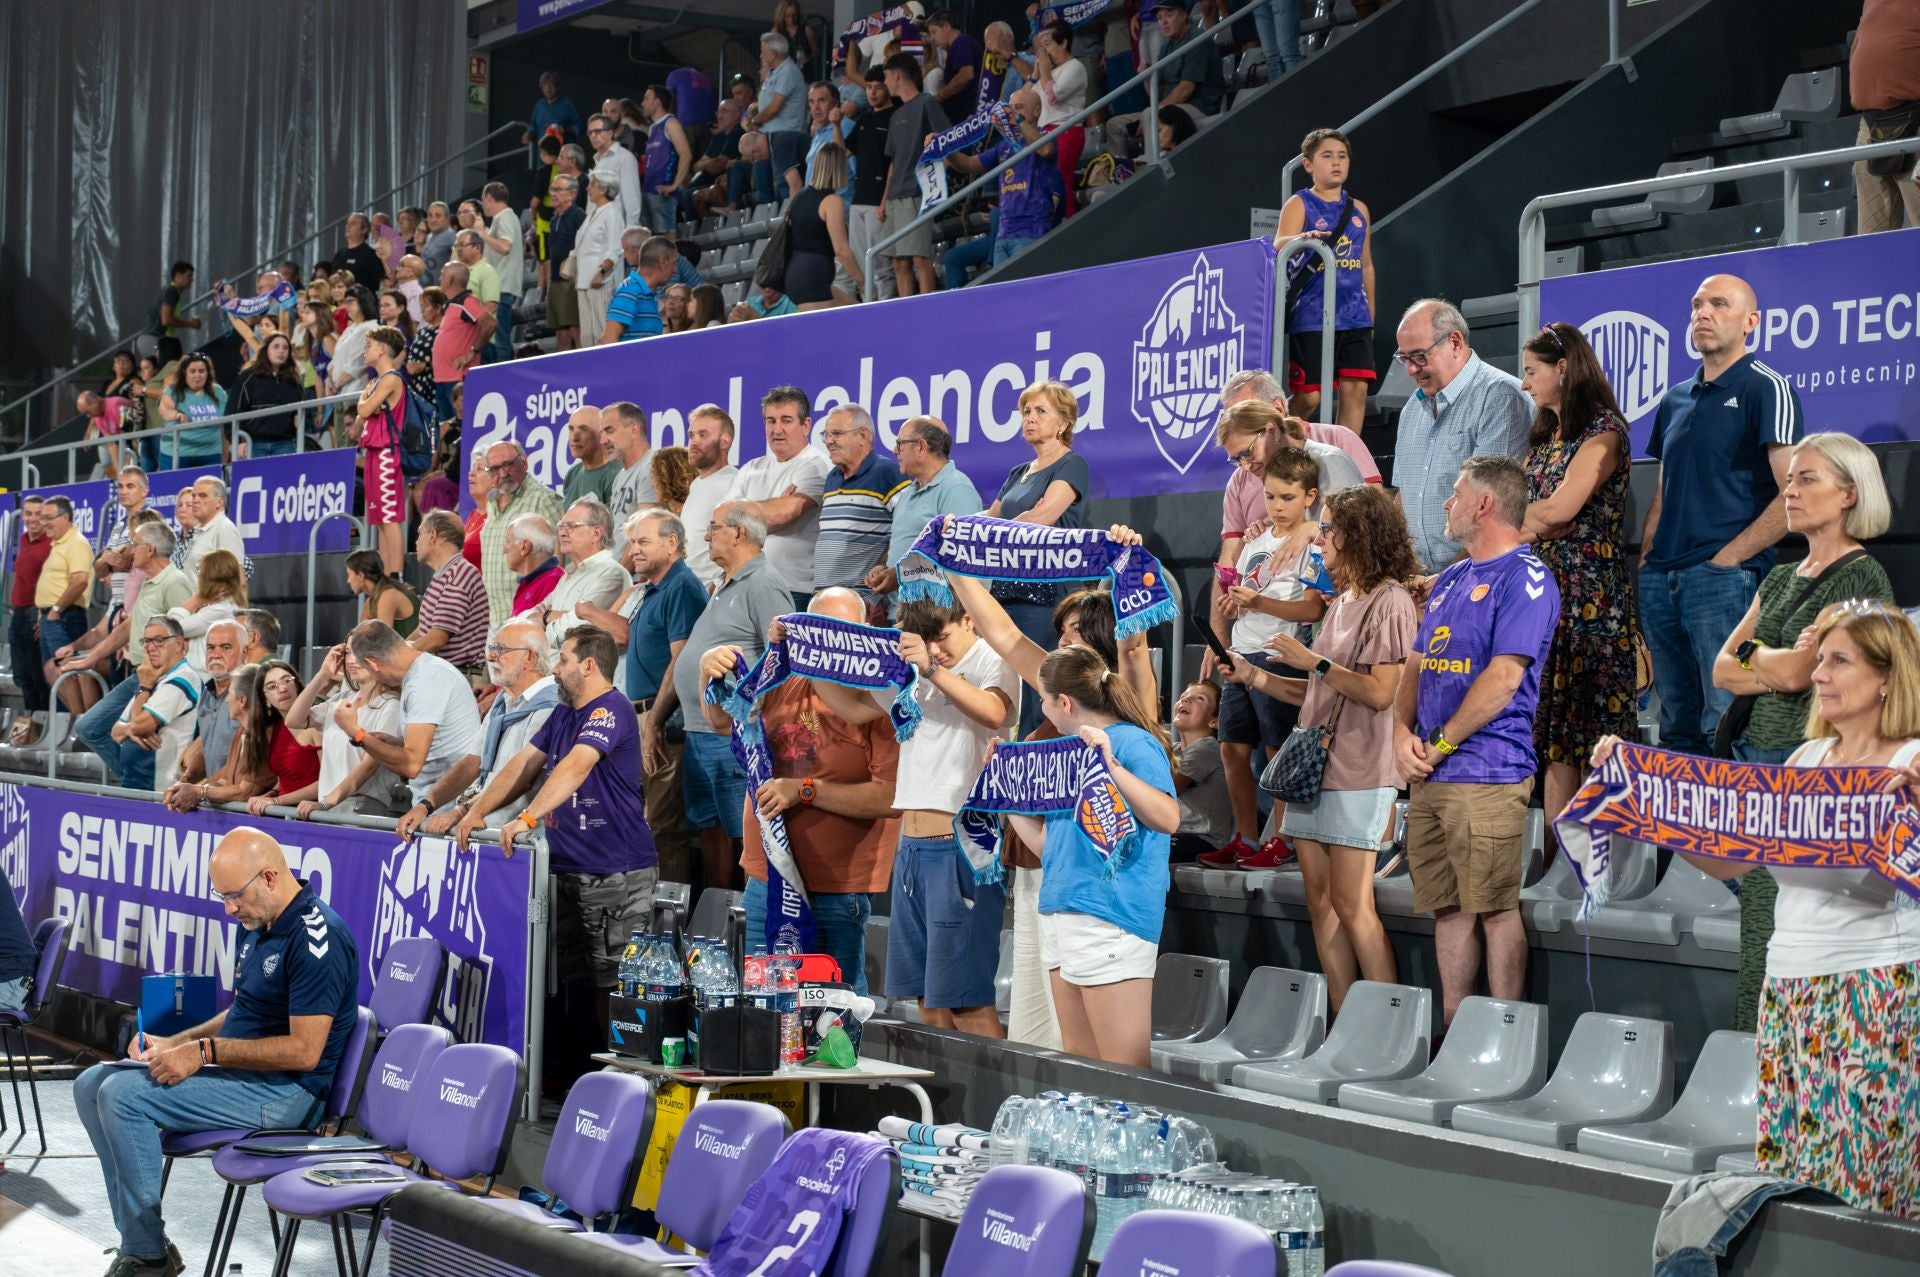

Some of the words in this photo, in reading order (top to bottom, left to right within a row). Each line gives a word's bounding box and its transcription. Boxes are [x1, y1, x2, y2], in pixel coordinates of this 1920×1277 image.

[1833, 292, 1920, 345] TEC
[1138, 338, 1238, 401] PALENCIA
[525, 383, 588, 425] súper
[811, 331, 1105, 455] alencia
[272, 473, 347, 524] cofersa
[941, 519, 1111, 547] SENTIMIENT
[1119, 588, 1152, 613] acb
[787, 640, 885, 678] ALENTINO.
[1420, 652, 1471, 674] ropal
[1637, 772, 1738, 834] PALENCIA
[53, 886, 238, 992] PALENTIN
[805, 989, 825, 1000] ISO
[612, 1019, 643, 1034] POWERADE
[440, 1084, 479, 1109] Villanova
[694, 1130, 742, 1160] Villanova
[981, 1217, 1032, 1252] Villanova
